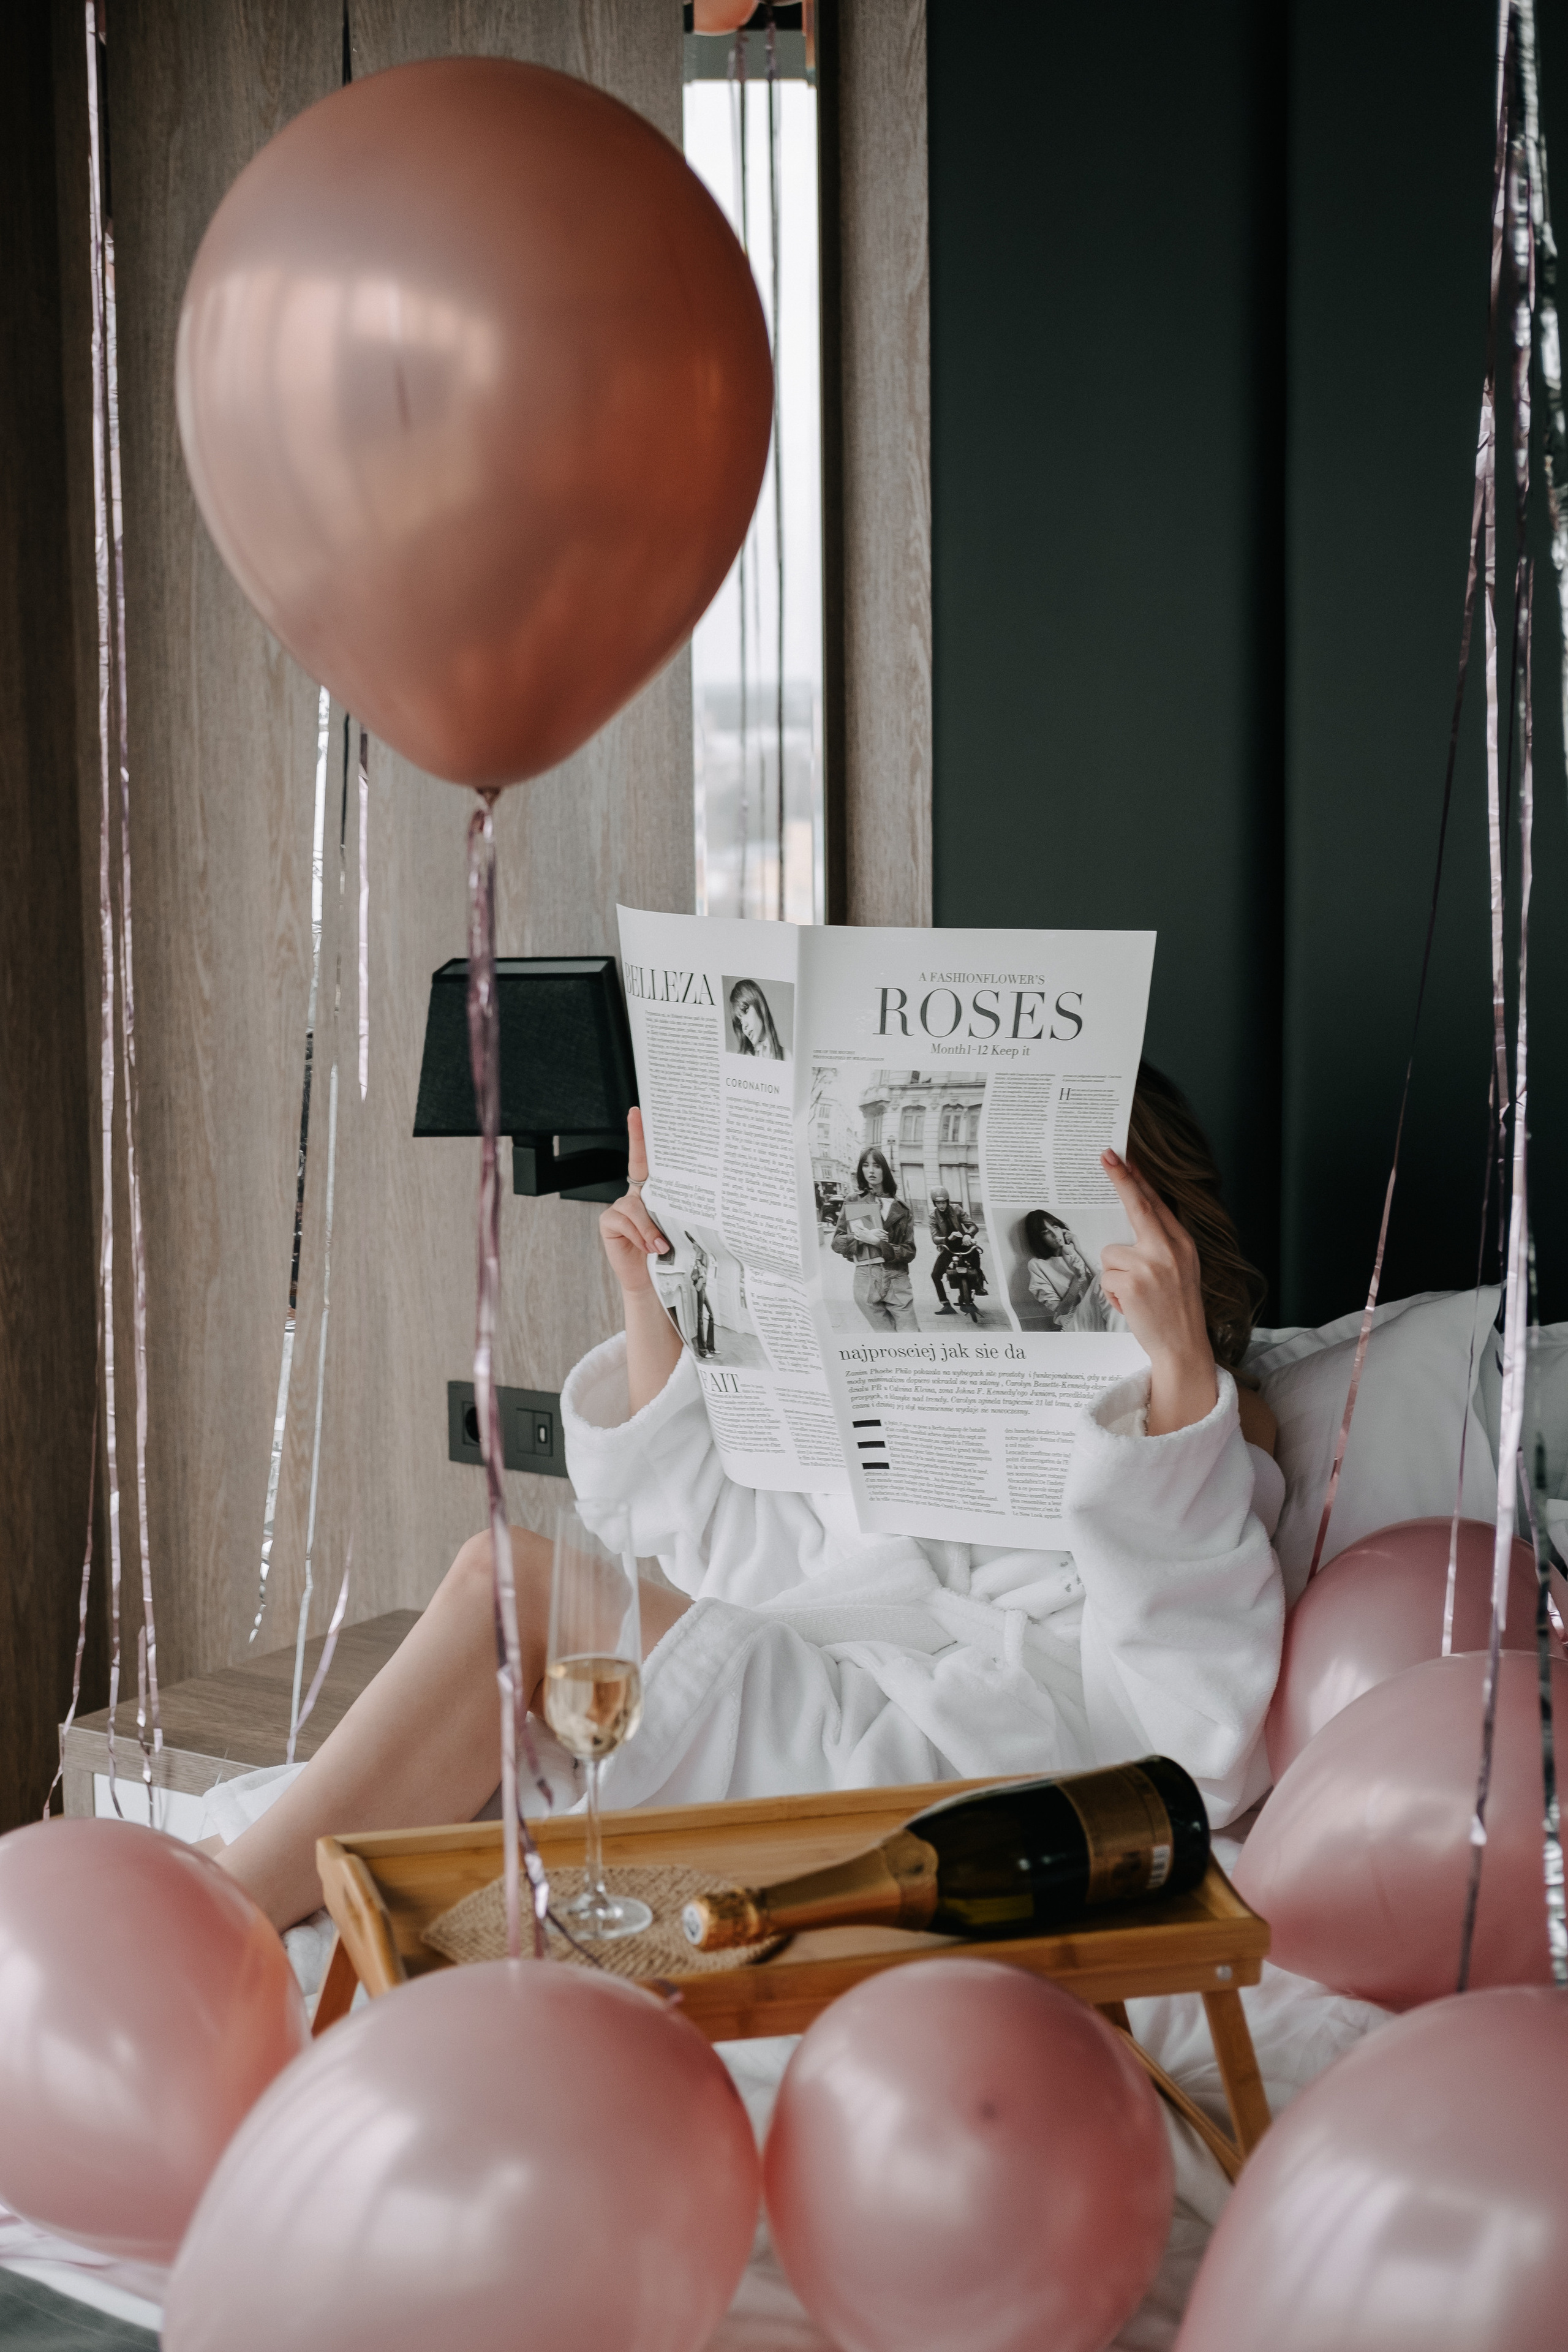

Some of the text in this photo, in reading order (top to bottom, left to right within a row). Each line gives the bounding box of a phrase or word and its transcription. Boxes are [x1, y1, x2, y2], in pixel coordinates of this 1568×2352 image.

[624, 962, 716, 1005] BELLEZA
[919, 972, 1044, 984] A FASHIONFLOWER'S
[873, 987, 1083, 1041] ROSES
[991, 1045, 1019, 1058] Keep
[1023, 1046, 1030, 1056] it
[726, 1078, 780, 1094] CORONATION
[839, 1343, 1025, 1362] najprosciej jak sie da
[906, 1377, 930, 1385] dopiero
[1005, 1380, 1031, 1389] Carolyn
[986, 1388, 1028, 1398] Kennedy'ego
[951, 1396, 976, 1405] Carolyn
